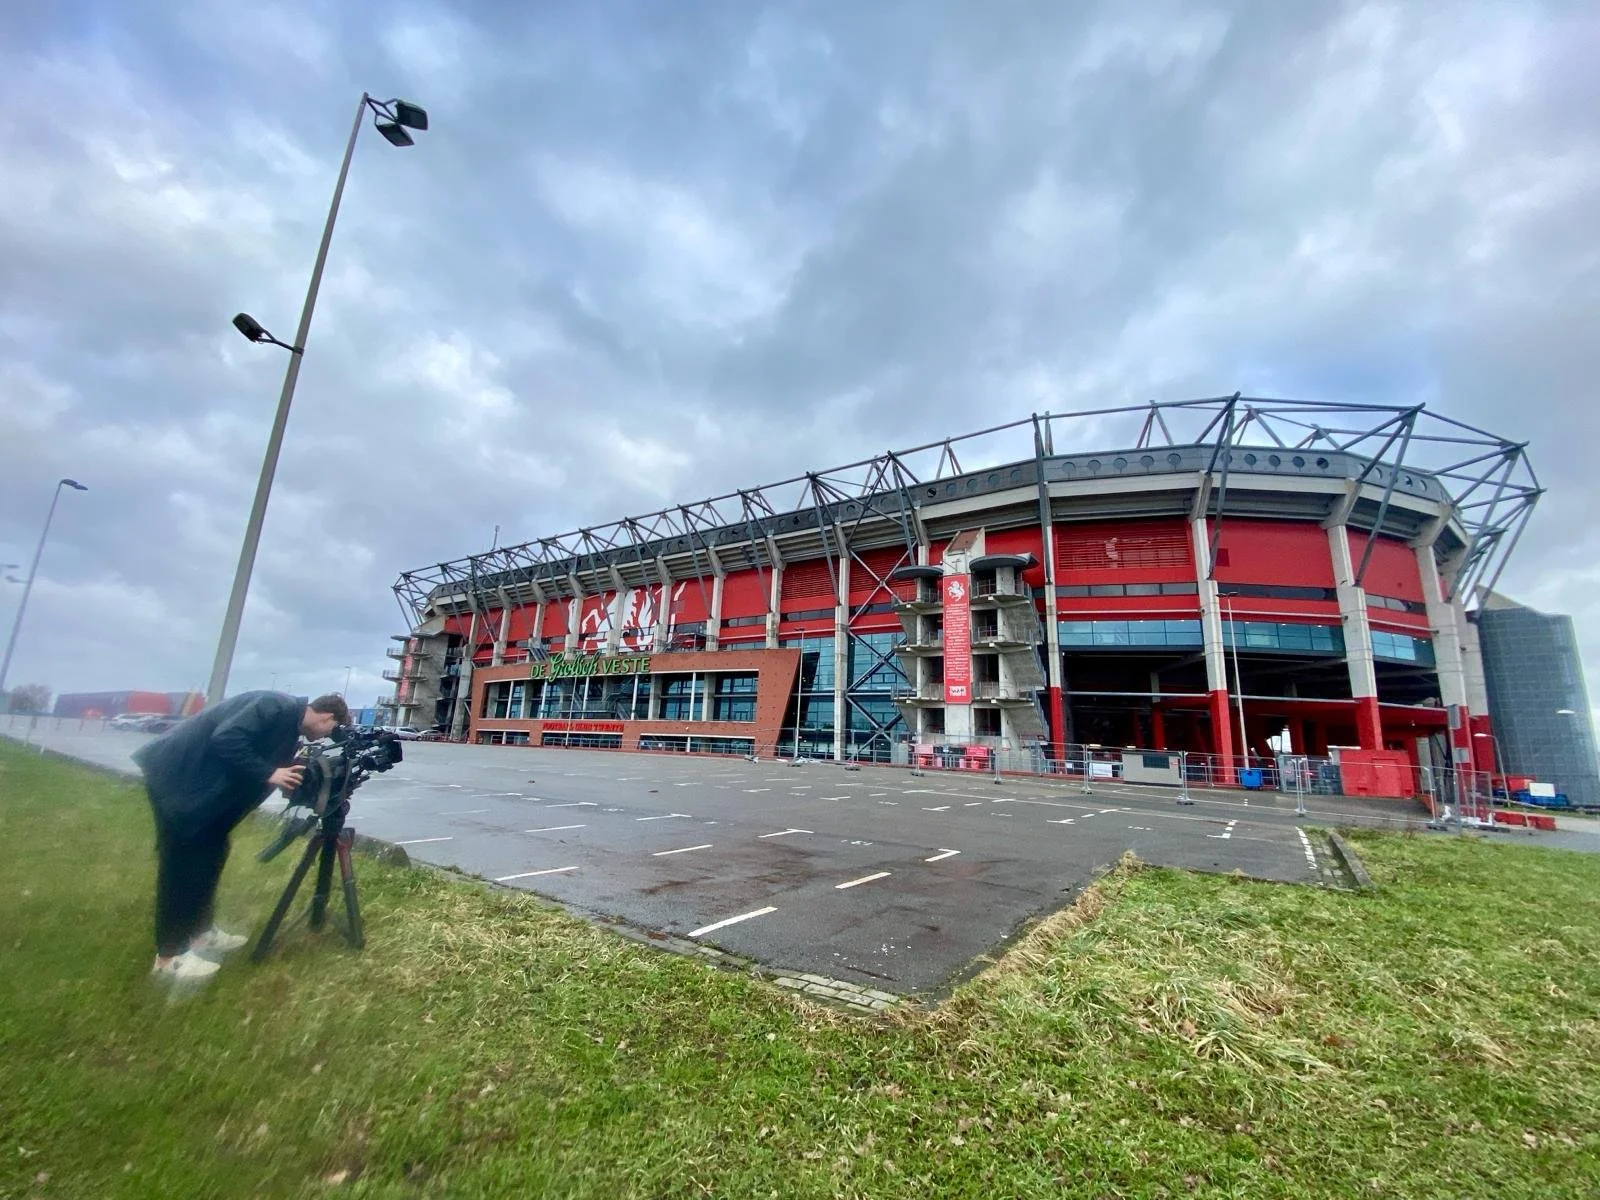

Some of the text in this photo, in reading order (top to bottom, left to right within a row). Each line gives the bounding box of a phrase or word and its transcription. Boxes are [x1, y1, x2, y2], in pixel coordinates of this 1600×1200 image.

[530, 650, 652, 682] DE Grolsch VESTE
